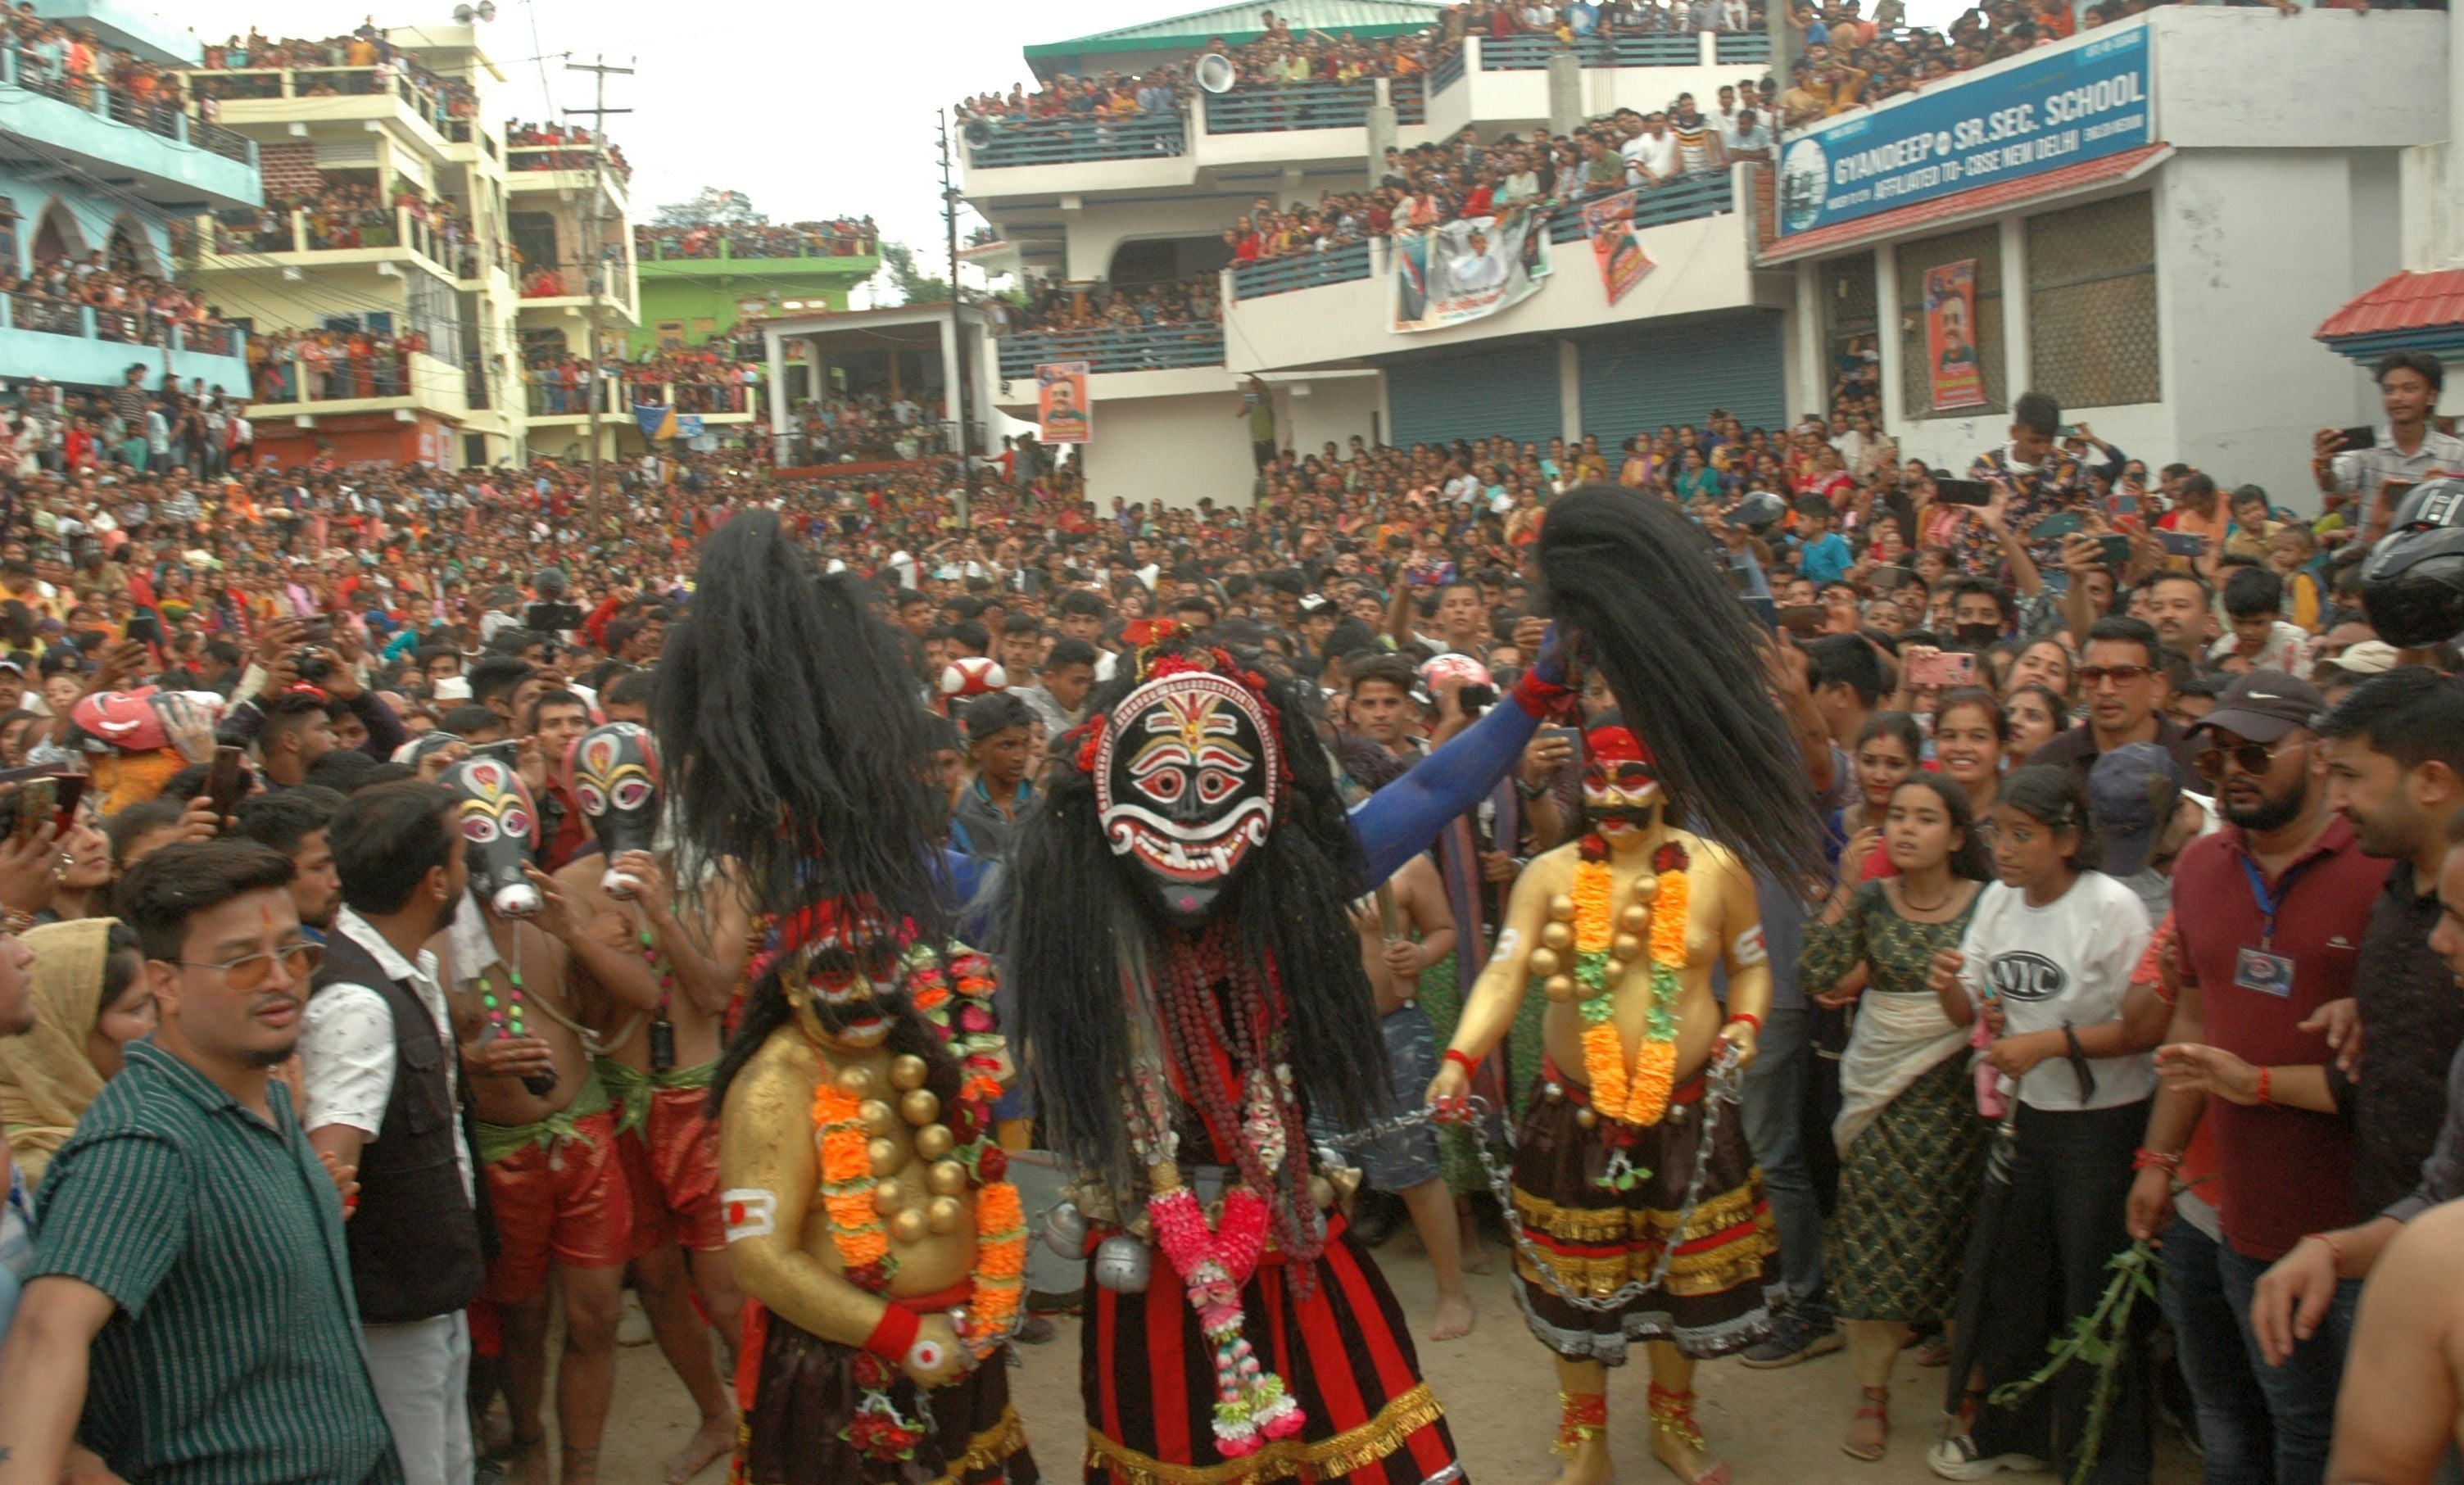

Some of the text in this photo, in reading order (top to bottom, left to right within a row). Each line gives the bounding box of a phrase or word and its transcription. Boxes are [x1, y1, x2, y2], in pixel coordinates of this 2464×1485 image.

[1834, 133, 1934, 184] GYANDEEP
[2044, 71, 2145, 126] SCHOOL
[1873, 165, 1941, 200] AFFILIATED
[1965, 150, 2001, 177] CBSE
[2002, 141, 2035, 168] NEW
[2036, 129, 2080, 160] DELHI
[1994, 959, 2058, 994] NYC
